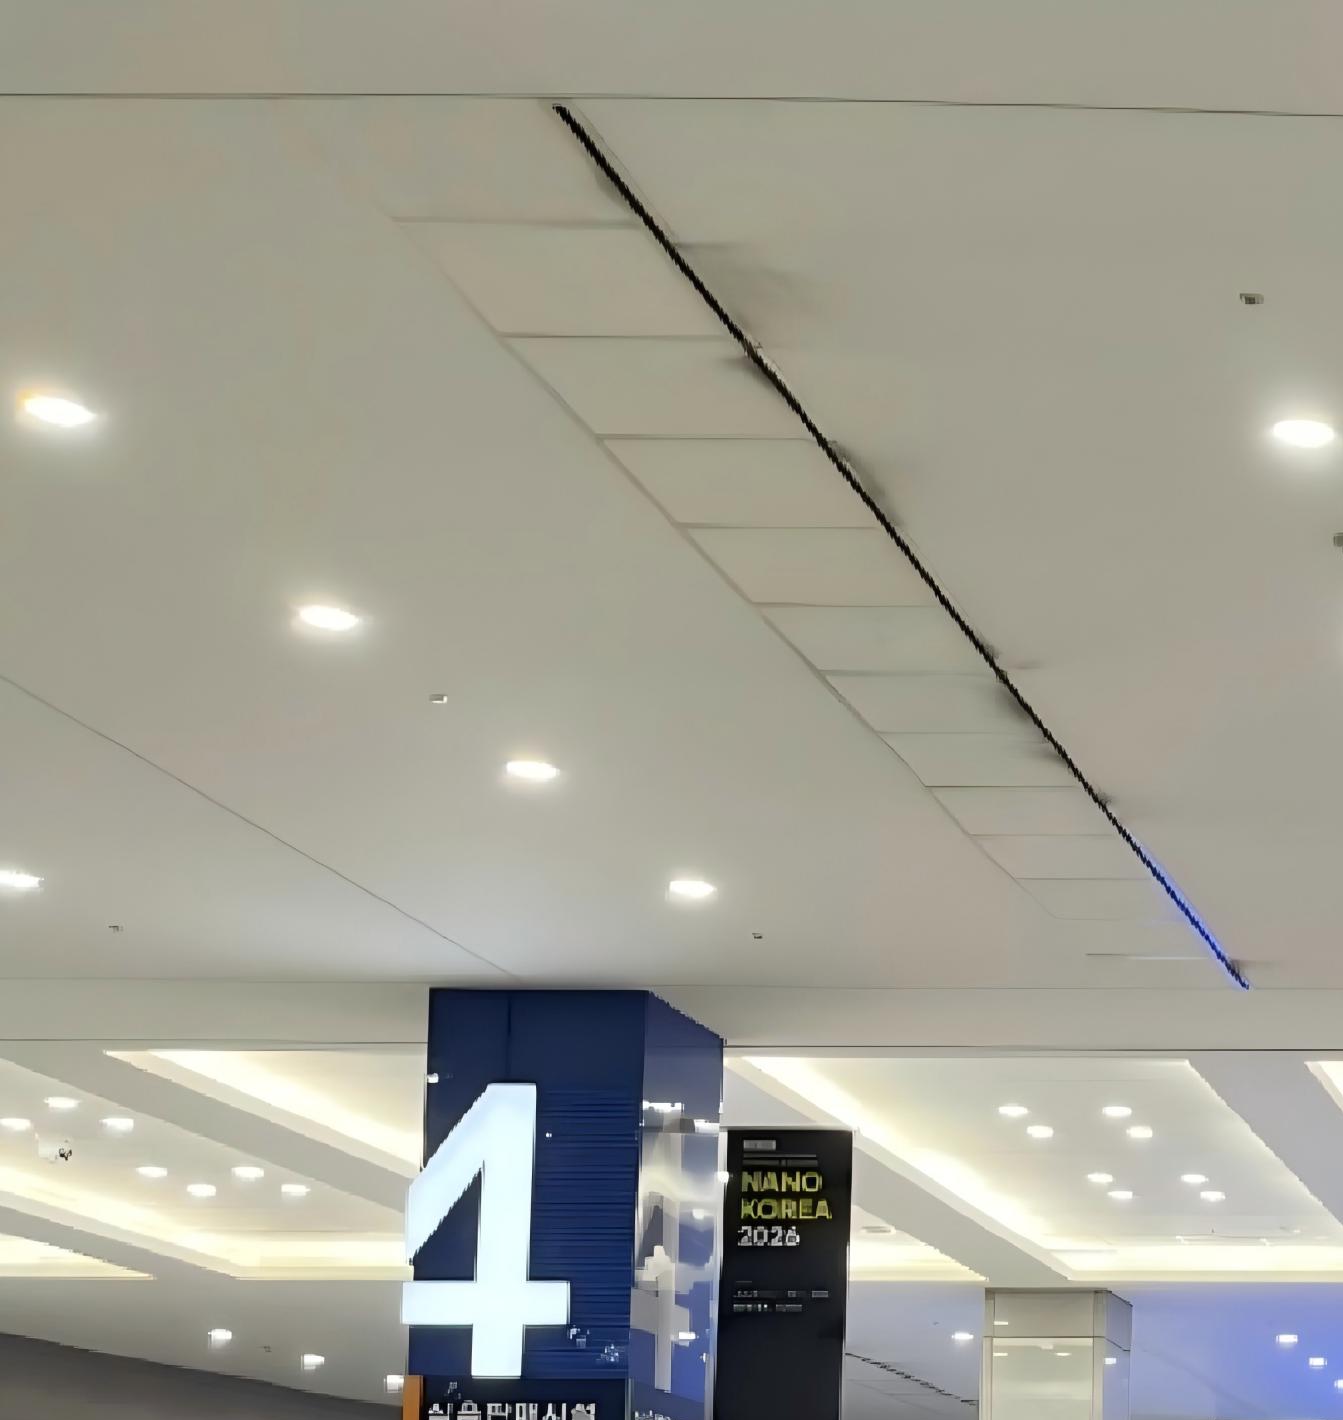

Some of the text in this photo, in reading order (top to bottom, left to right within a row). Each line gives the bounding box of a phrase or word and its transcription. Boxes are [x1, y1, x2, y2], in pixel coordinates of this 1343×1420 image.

[741, 1171, 822, 1192] NANO
[740, 1198, 833, 1220] KOREA
[401, 1082, 571, 1379] 4
[737, 1226, 800, 1246] 2026
